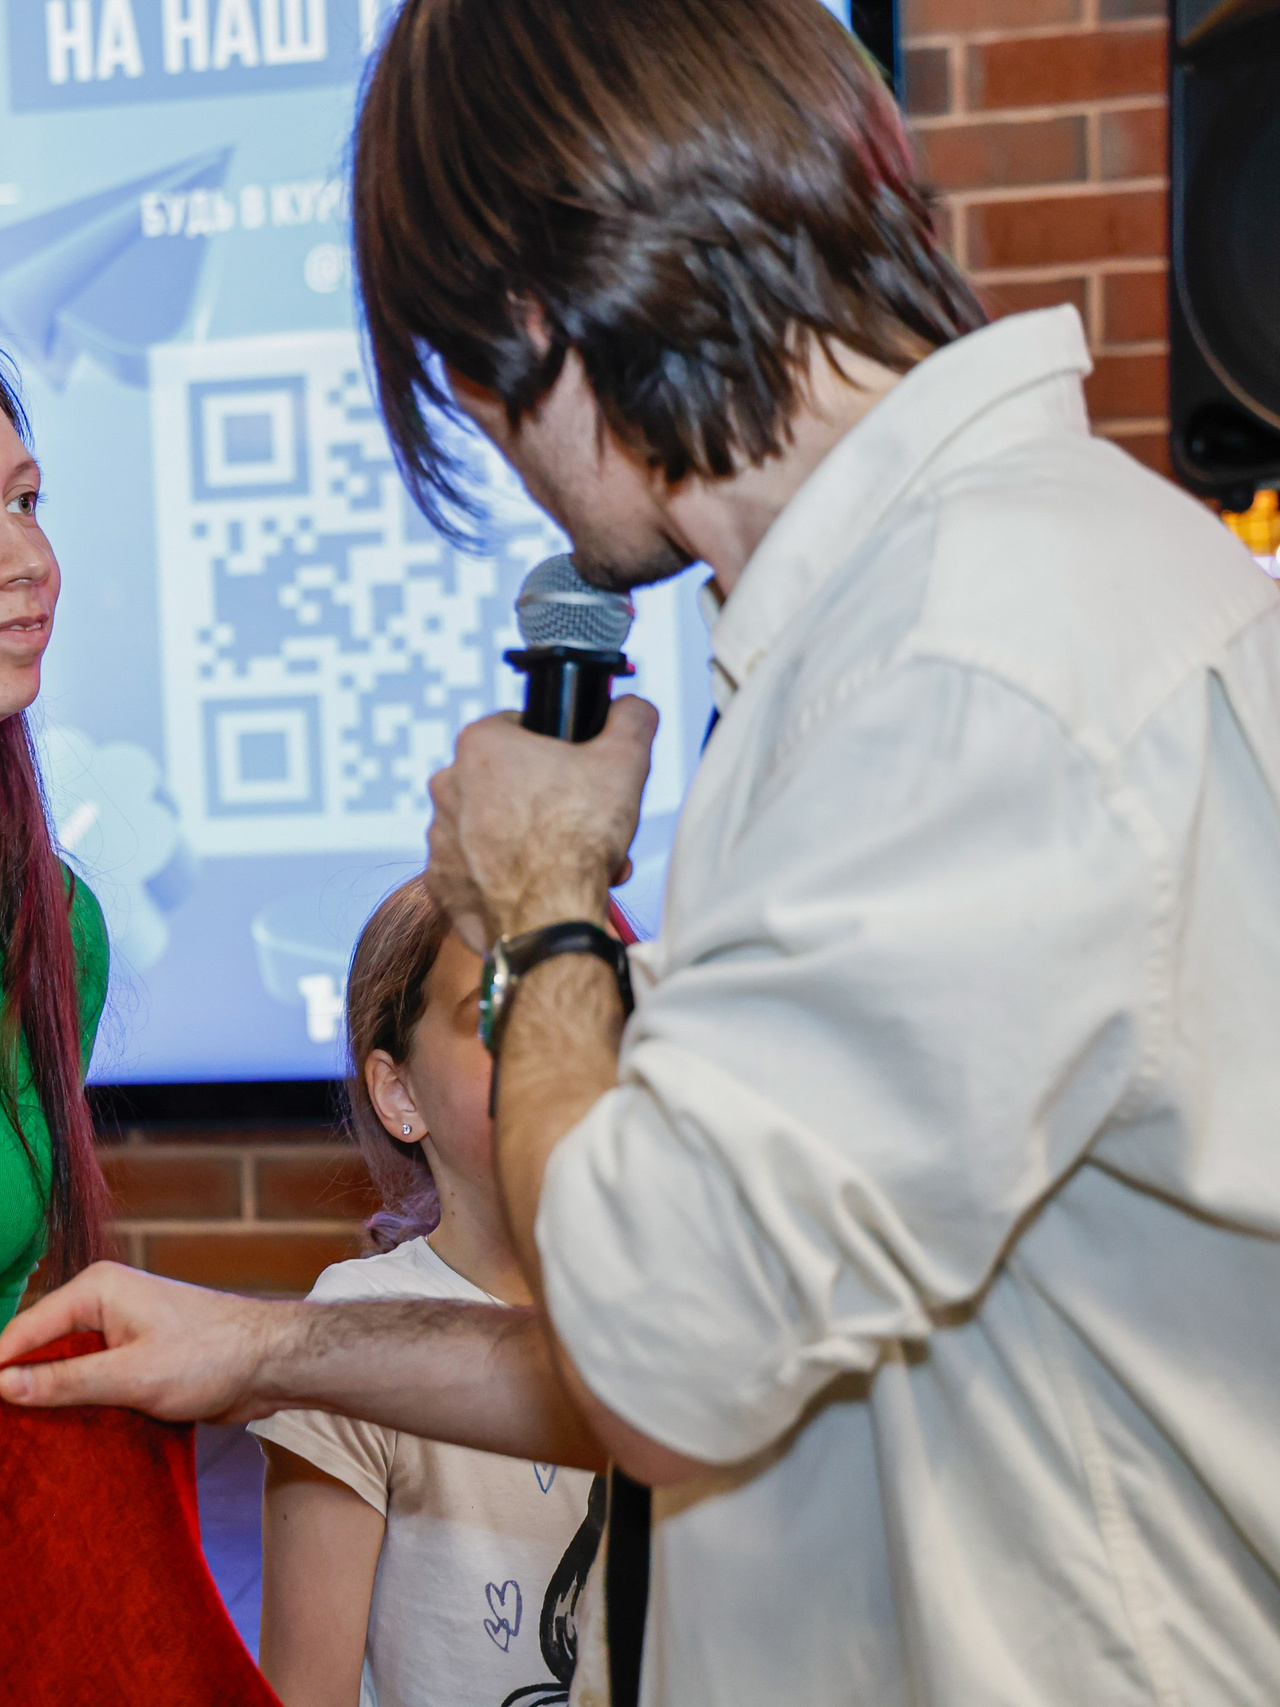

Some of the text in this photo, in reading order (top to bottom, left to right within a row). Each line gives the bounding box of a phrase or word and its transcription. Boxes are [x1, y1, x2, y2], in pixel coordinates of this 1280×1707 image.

[46, 0, 143, 84] НА
[162, 0, 328, 74] НАШ
[139, 188, 235, 239] БУДЬ
[271, 180, 351, 226] КУР
